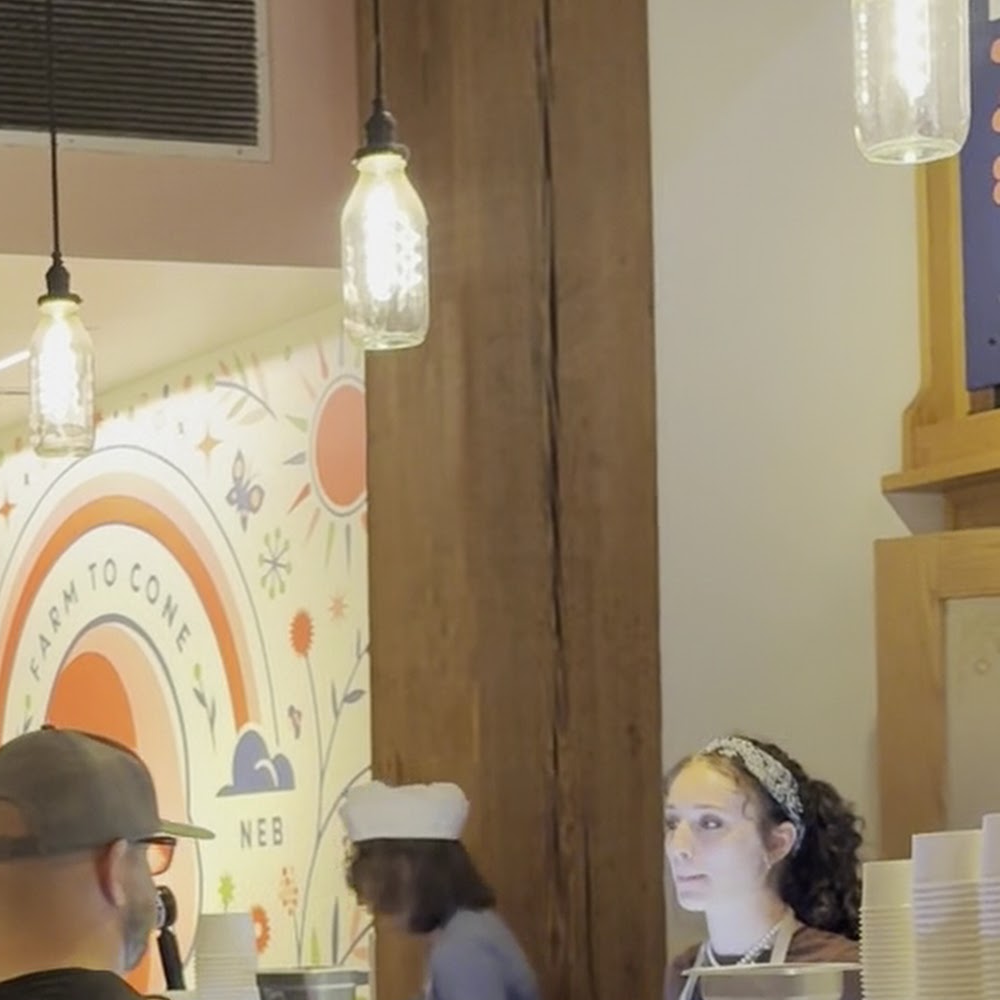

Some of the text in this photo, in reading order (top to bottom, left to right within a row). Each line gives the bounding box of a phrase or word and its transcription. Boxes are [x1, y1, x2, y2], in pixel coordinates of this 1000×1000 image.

[30, 558, 192, 682] FARM TO CONE
[239, 816, 284, 849] NEB
